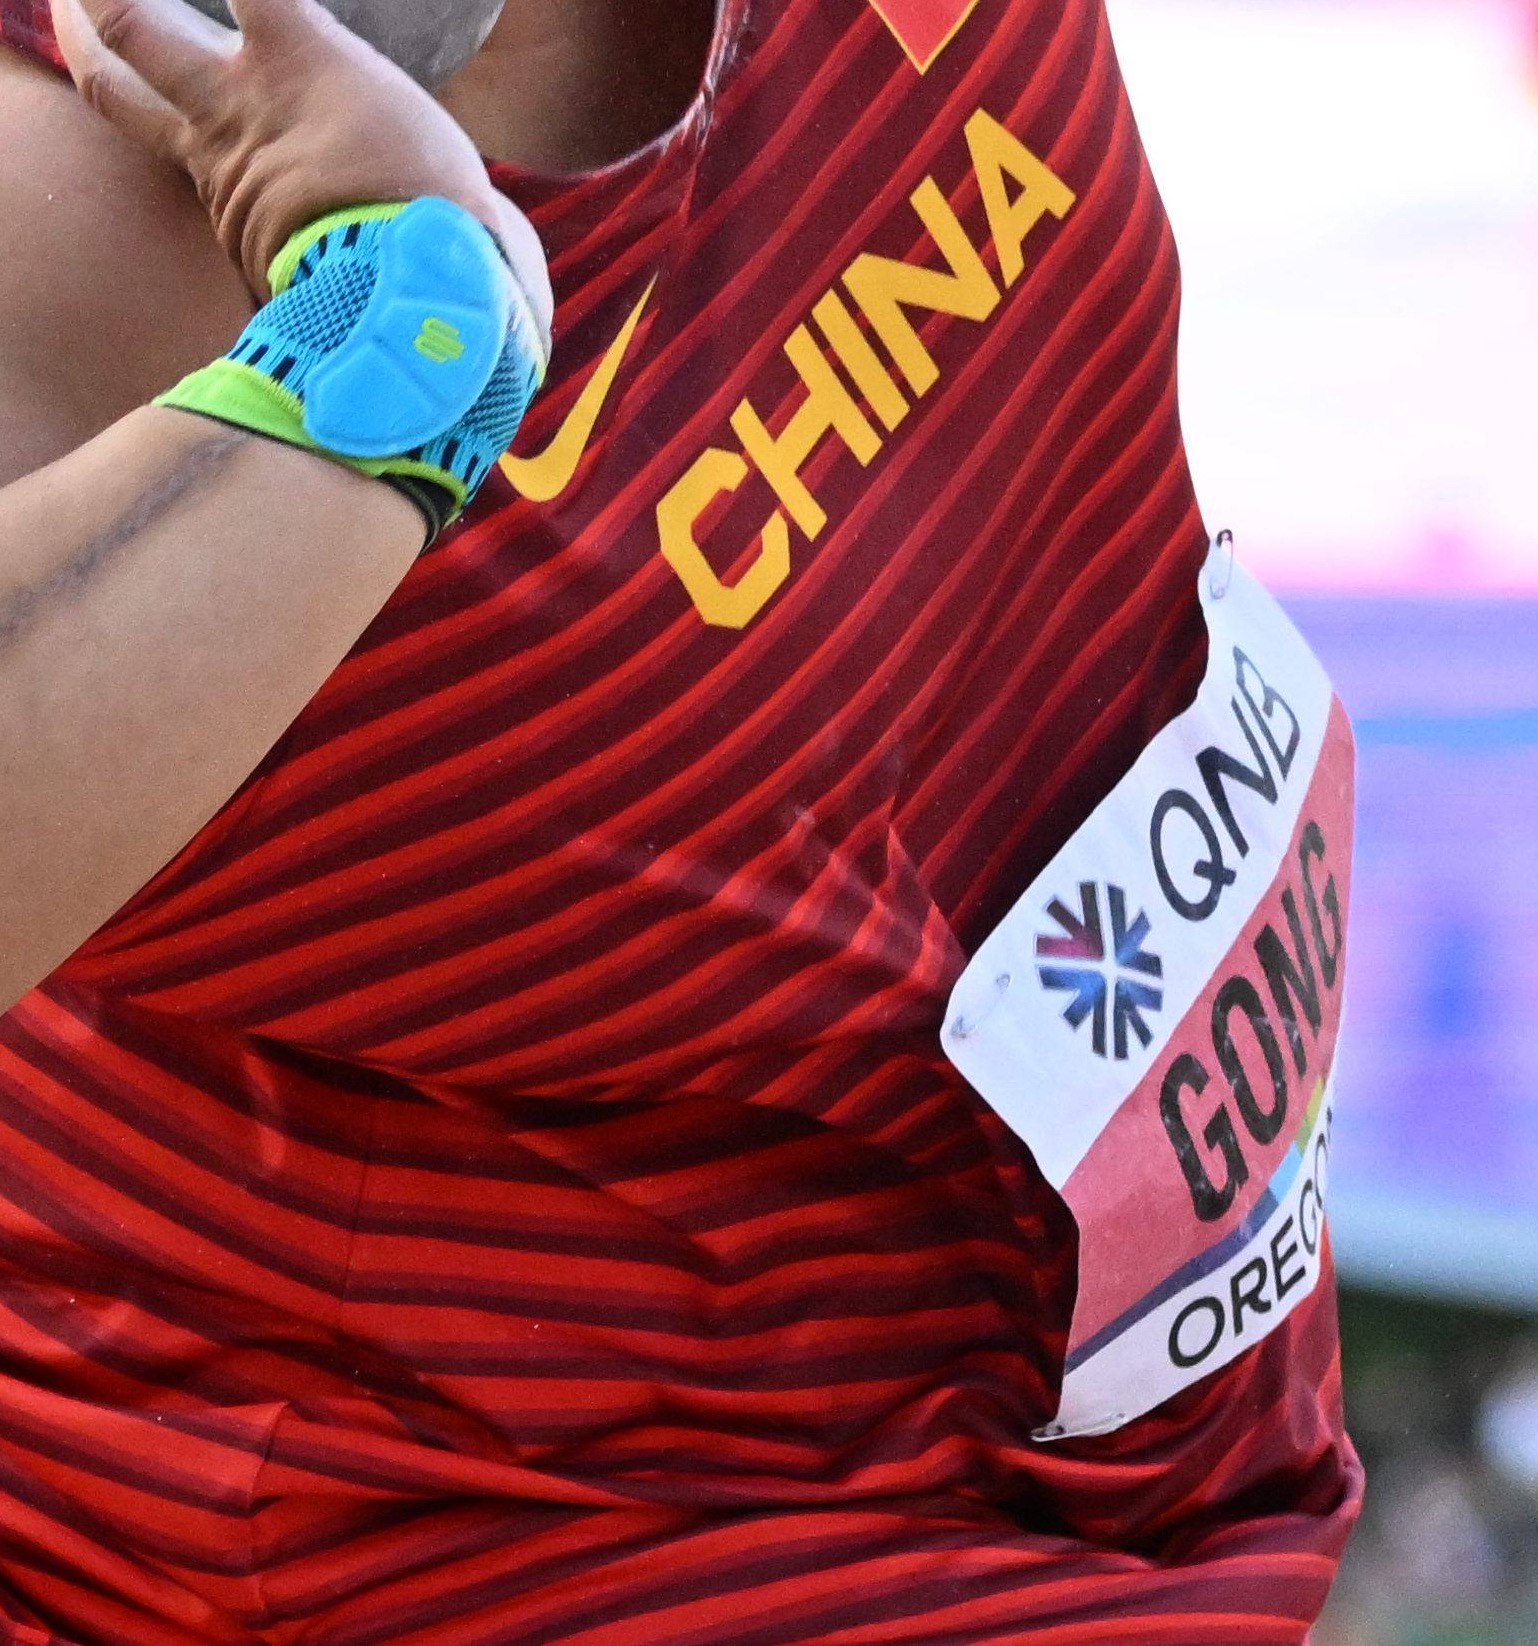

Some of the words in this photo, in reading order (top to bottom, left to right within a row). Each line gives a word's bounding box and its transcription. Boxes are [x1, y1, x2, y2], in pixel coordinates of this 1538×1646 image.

[656, 107, 1076, 630] CHINA
[1150, 646, 1301, 922] QNB
[1159, 819, 1343, 1223] GONG
[1168, 1106, 1332, 1369] OREGO
